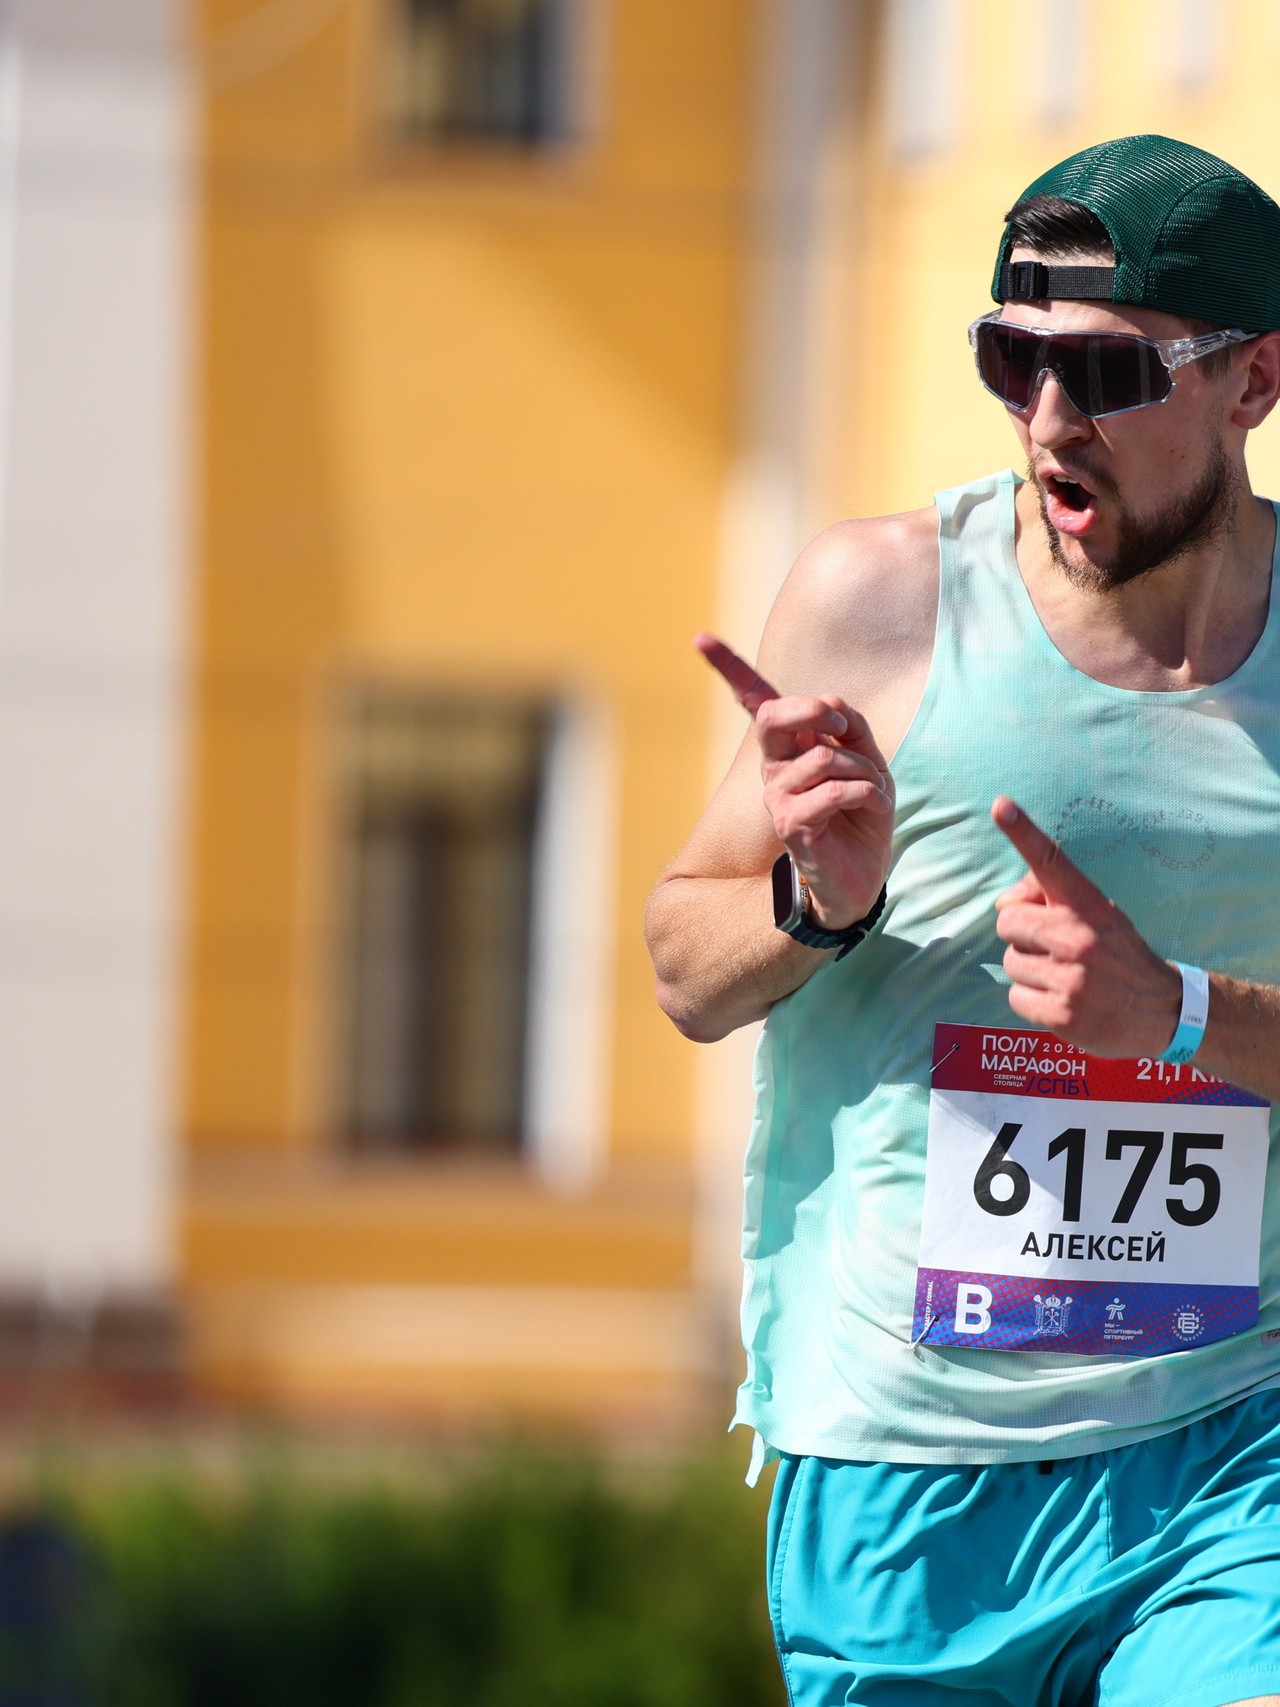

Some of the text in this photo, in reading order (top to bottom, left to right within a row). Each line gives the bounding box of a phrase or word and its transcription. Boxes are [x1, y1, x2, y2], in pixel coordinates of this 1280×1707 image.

[982, 1034, 1039, 1053] ПОЛУ
[981, 1053, 1086, 1076] МАРАФОН
[993, 1073, 1027, 1081] СЕВЕРНАЯ
[1136, 1057, 1181, 1085] 21,1
[973, 1122, 1224, 1227] 6175
[1020, 1230, 1166, 1262] АЛЕКСЕЙ
